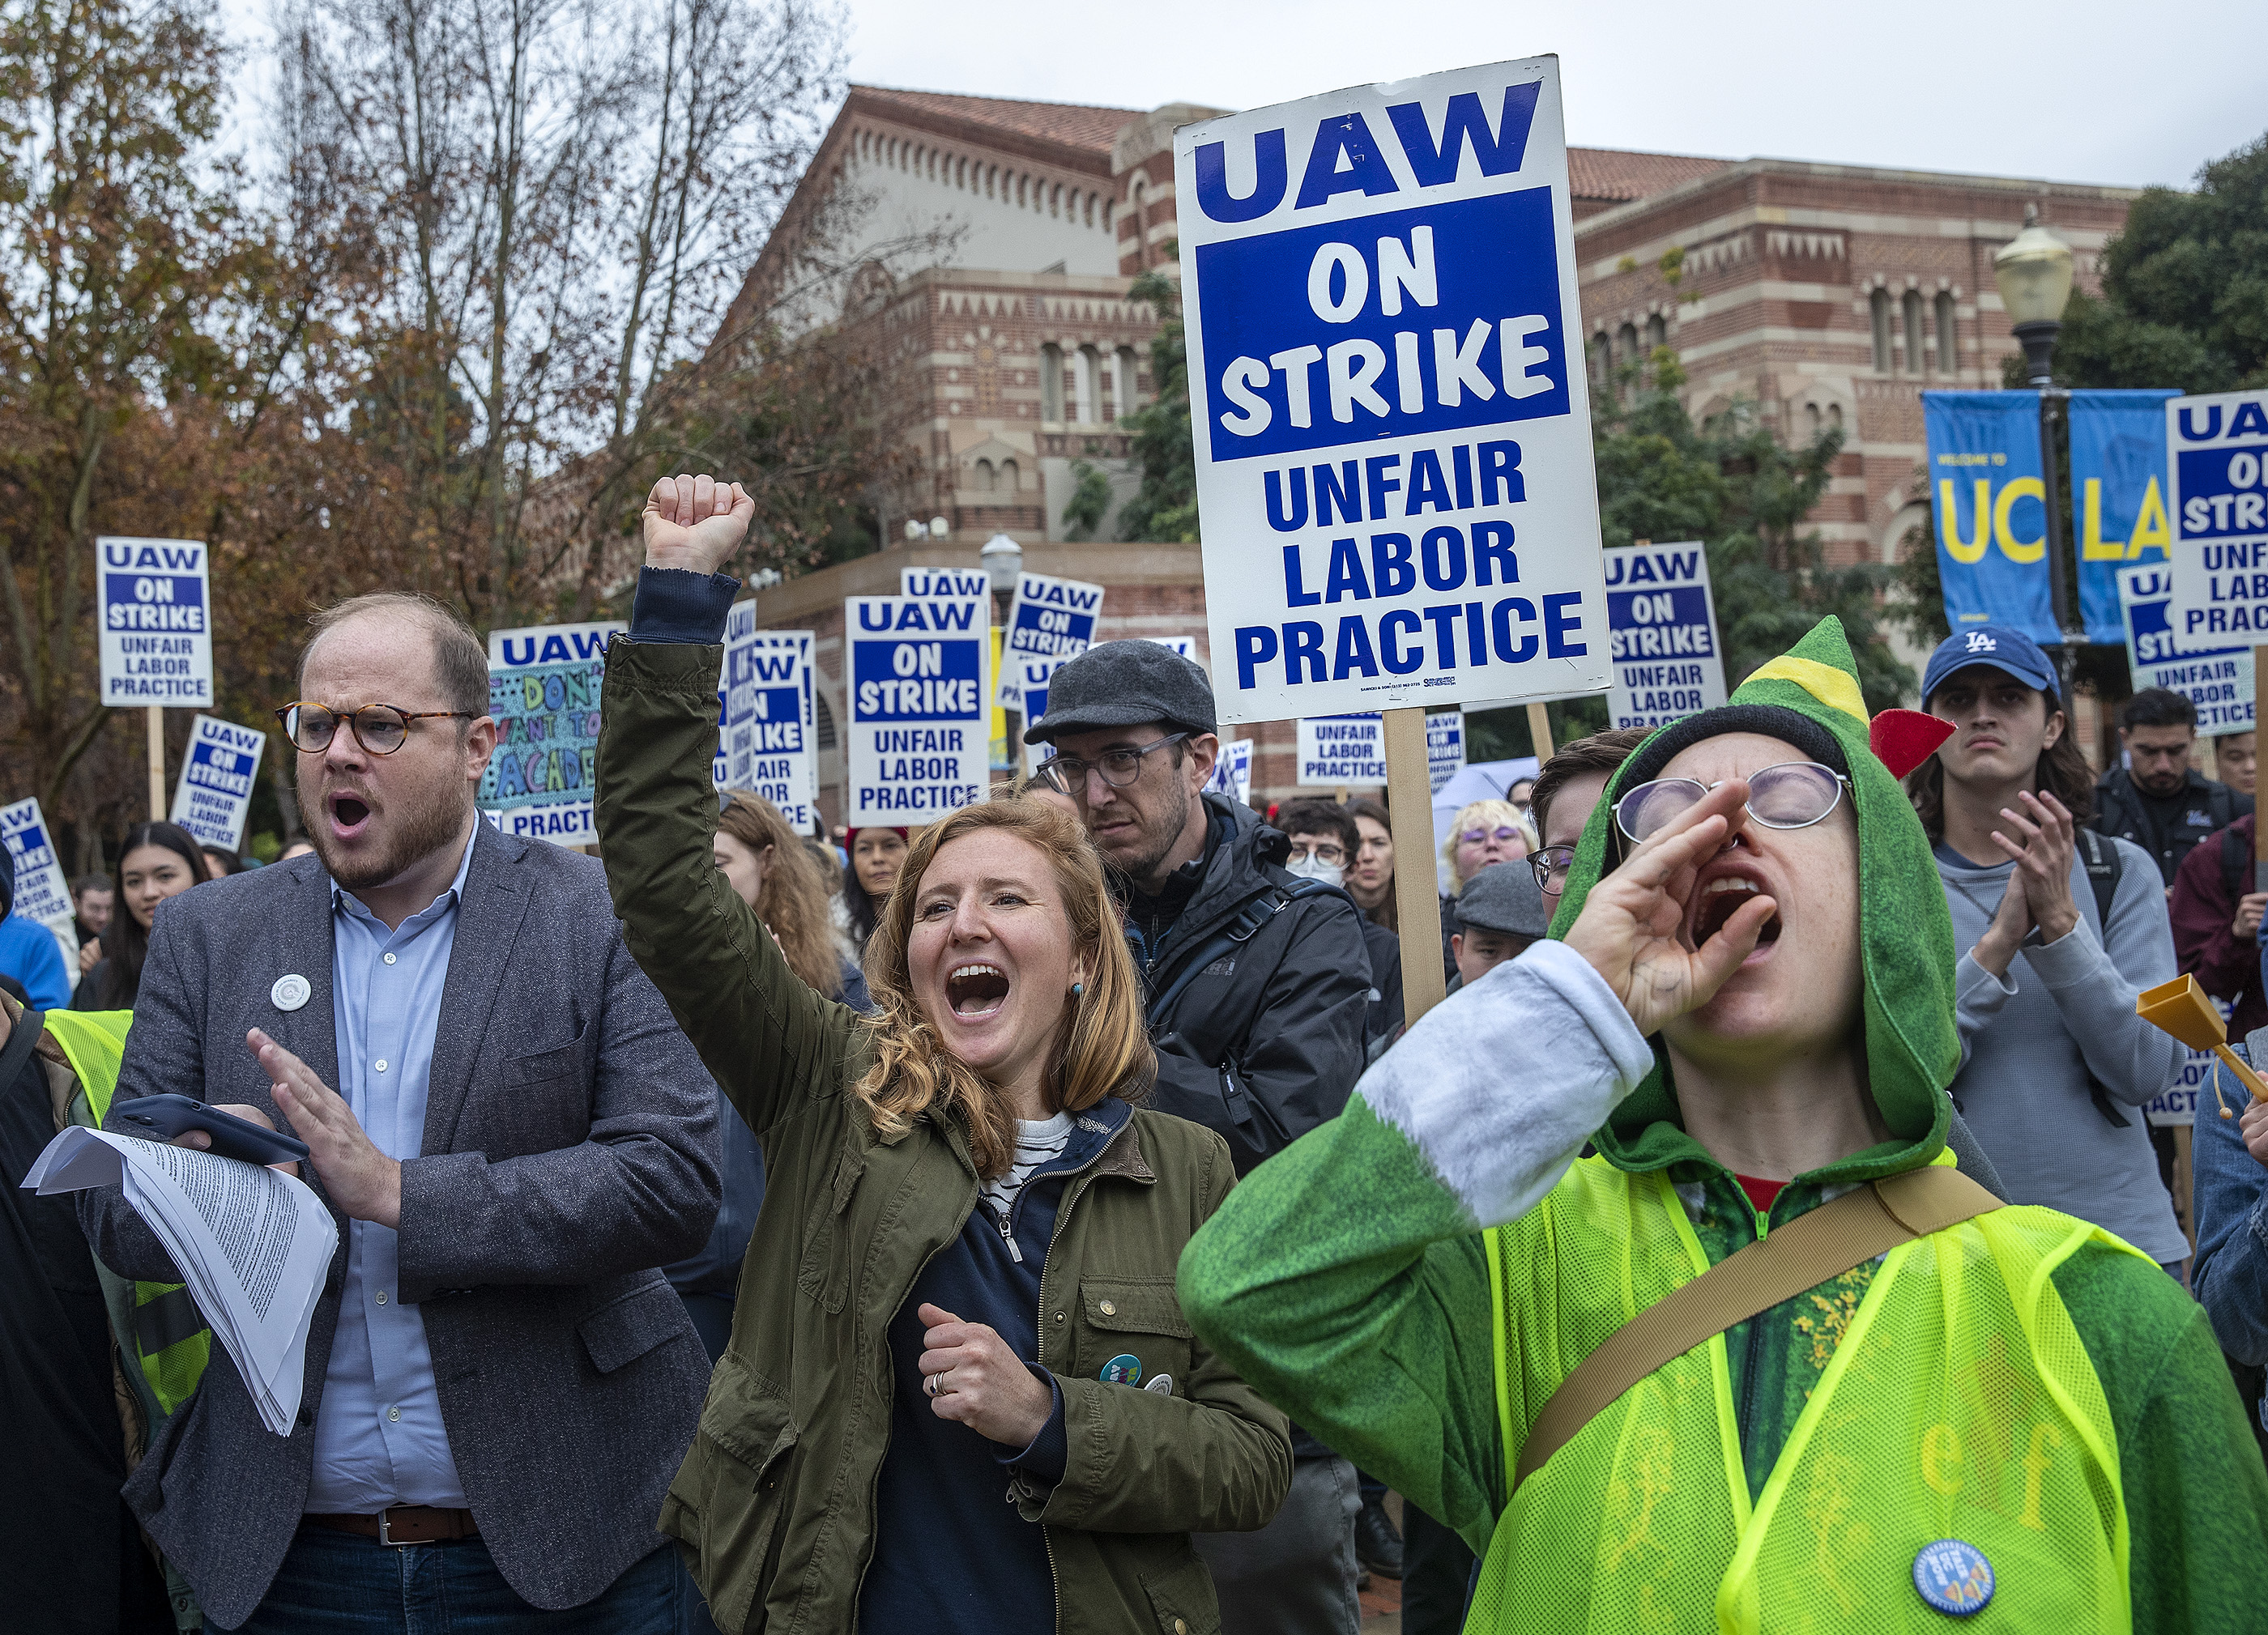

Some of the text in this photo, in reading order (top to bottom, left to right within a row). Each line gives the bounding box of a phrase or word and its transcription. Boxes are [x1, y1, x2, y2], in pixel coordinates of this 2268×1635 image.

[1195, 81, 1541, 224] UAW
[1307, 225, 1439, 323] ON
[1220, 314, 1554, 436] STRIKE
[1264, 439, 1527, 532] UNFAIR
[1938, 475, 2171, 564] UC LA
[106, 546, 199, 568] UAW
[1283, 520, 1520, 607] LABOR
[1604, 551, 1699, 585] UAW
[134, 577, 174, 603] ON
[909, 576, 986, 596] UAW
[1023, 580, 1099, 610] UAW
[2210, 574, 2268, 602] LAB
[108, 602, 202, 630] STRIKE
[859, 602, 976, 632] UAW
[1631, 591, 1676, 625] ON
[1038, 609, 1072, 635] ON
[122, 637, 194, 654] UNFAIR
[502, 630, 620, 666] UAW
[1013, 626, 1089, 657] STRIKE
[1234, 591, 1588, 690] PRACTICE
[1610, 623, 1713, 659] STRIKE
[1965, 632, 1997, 654] LA
[126, 658, 190, 675] LABOR
[892, 642, 943, 678] ON
[111, 678, 207, 696] PRACTICE
[1622, 664, 1703, 688] UNFAIR
[2156, 661, 2237, 687] UNFAIR
[857, 678, 978, 716] STRIKE
[1630, 690, 1703, 713] LABOR
[2179, 683, 2236, 705] BOR
[203, 722, 258, 750] UAW
[569, 713, 601, 738] TO
[1315, 725, 1377, 741] UNFAIR
[874, 729, 964, 753] UNFAIR
[1319, 744, 1373, 759] LABOR
[209, 747, 238, 772] ON
[880, 757, 959, 781] LABOR
[1305, 761, 1387, 778] PRACTICE
[188, 760, 250, 794] STRIKE
[859, 784, 981, 811] PRACTICE
